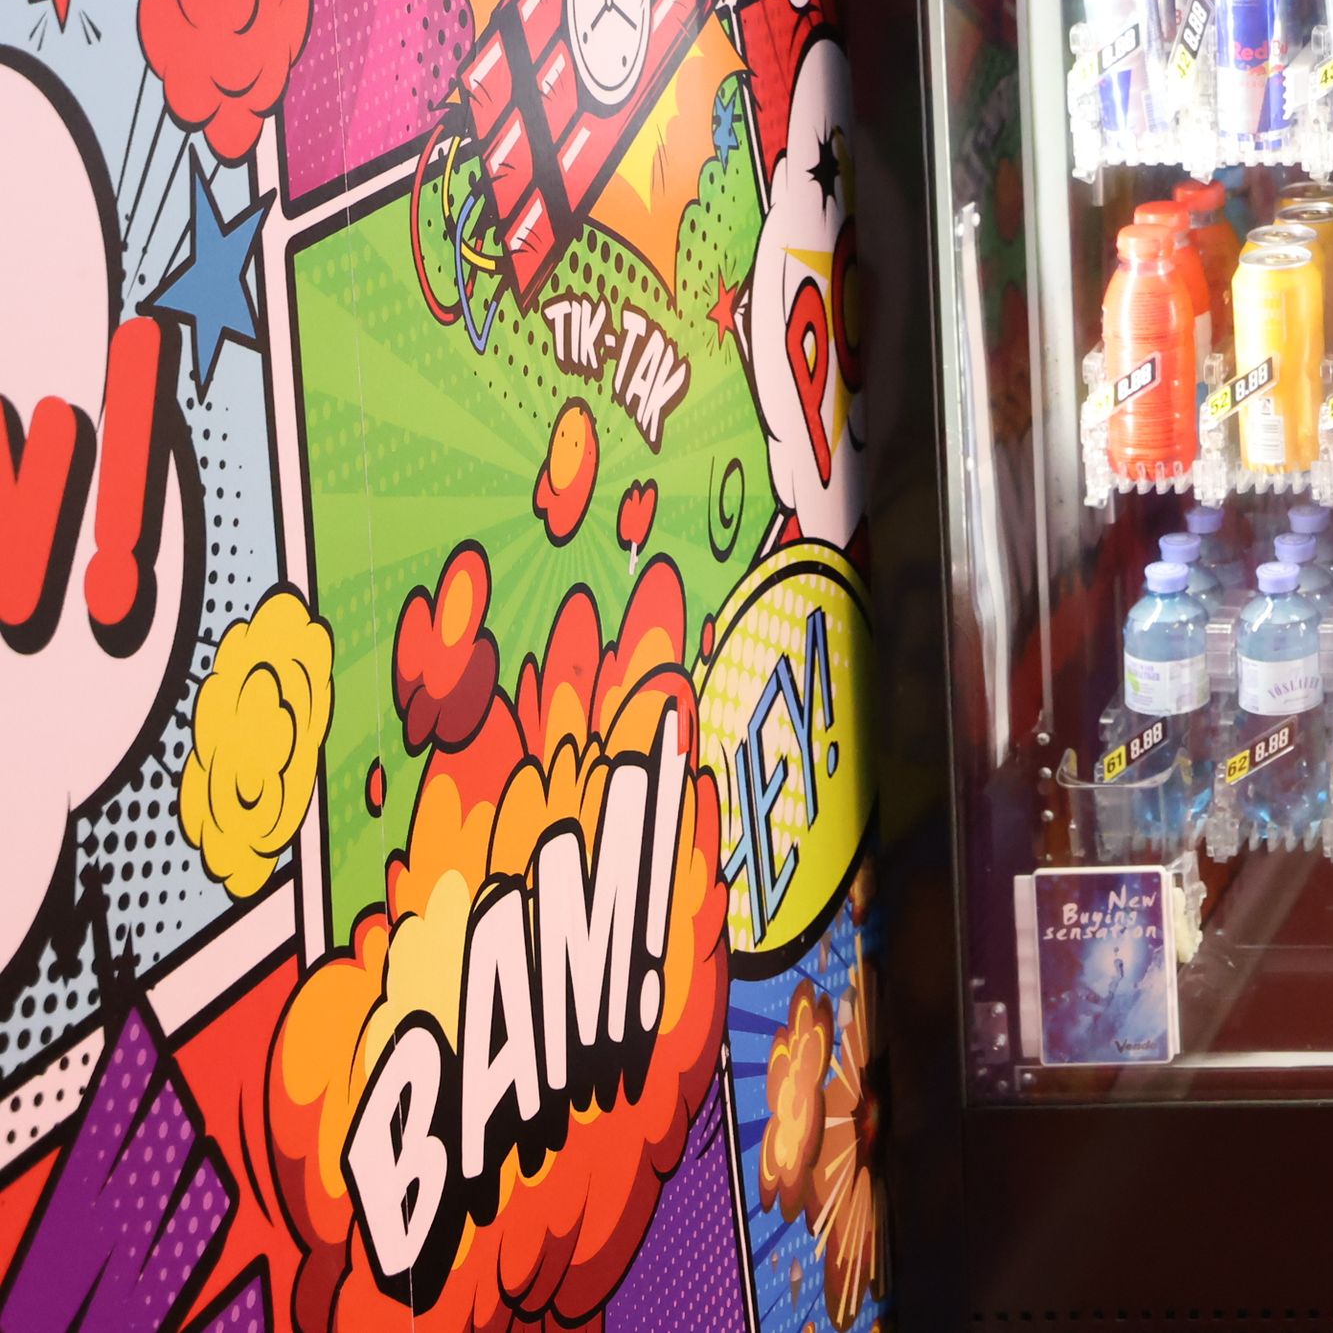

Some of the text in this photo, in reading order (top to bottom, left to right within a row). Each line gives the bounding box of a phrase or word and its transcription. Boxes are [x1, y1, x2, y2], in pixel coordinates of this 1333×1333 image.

[545, 300, 689, 452] TIK-TAK
[1234, 362, 1269, 402] 8.88
[1267, 675, 1321, 702] VÖSLAUER
[1107, 721, 1164, 775] 61 8.88
[1226, 726, 1289, 779] 62 8.88
[722, 607, 838, 945] HEY!
[1062, 902, 1139, 927] Buying
[1108, 883, 1157, 911] New
[1042, 925, 1157, 941] sensation
[348, 708, 690, 1278] BAM!
